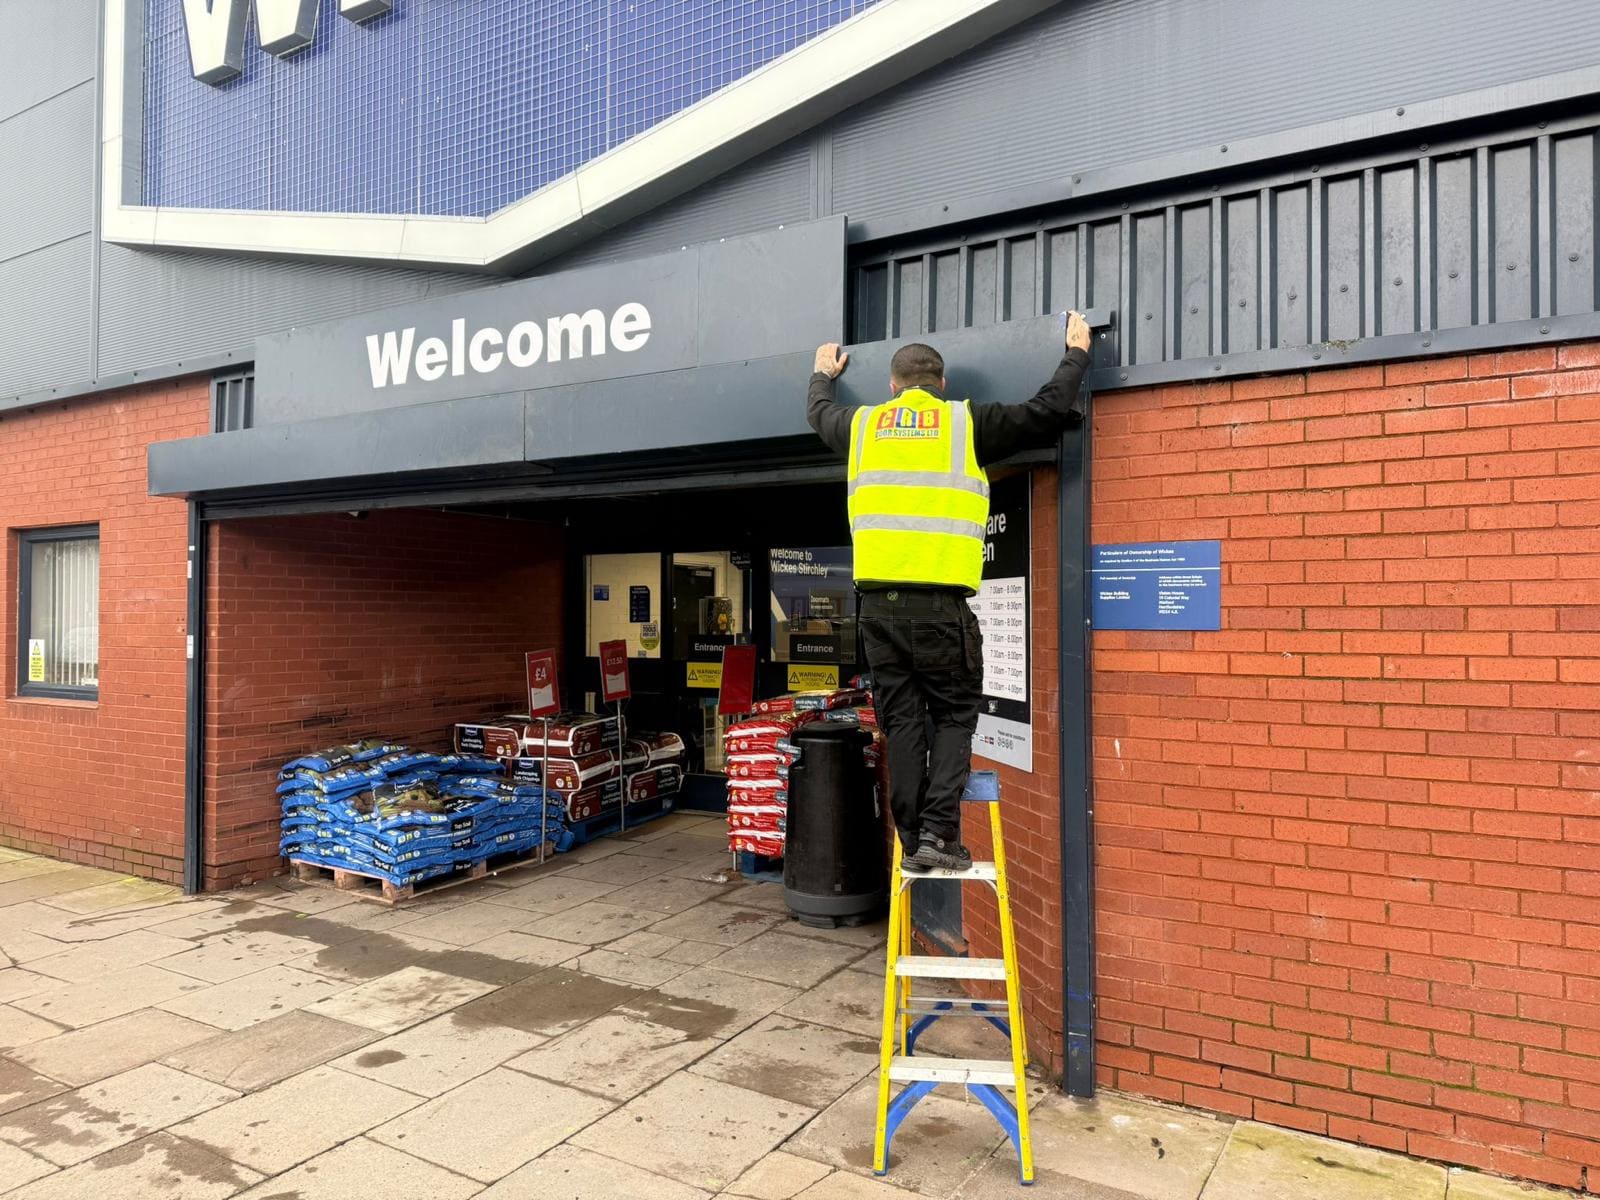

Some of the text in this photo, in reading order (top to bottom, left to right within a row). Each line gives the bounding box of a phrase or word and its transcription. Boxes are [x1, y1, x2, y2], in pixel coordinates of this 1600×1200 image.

[366, 302, 652, 389] Welcome
[894, 429, 925, 437] SYSTEMS
[926, 429, 939, 437] LTD
[987, 513, 1007, 535] are
[770, 548, 813, 561] Welcome to
[770, 560, 829, 578] Wickes Stirchley
[797, 643, 833, 653] Entrance
[535, 667, 546, 681] £4
